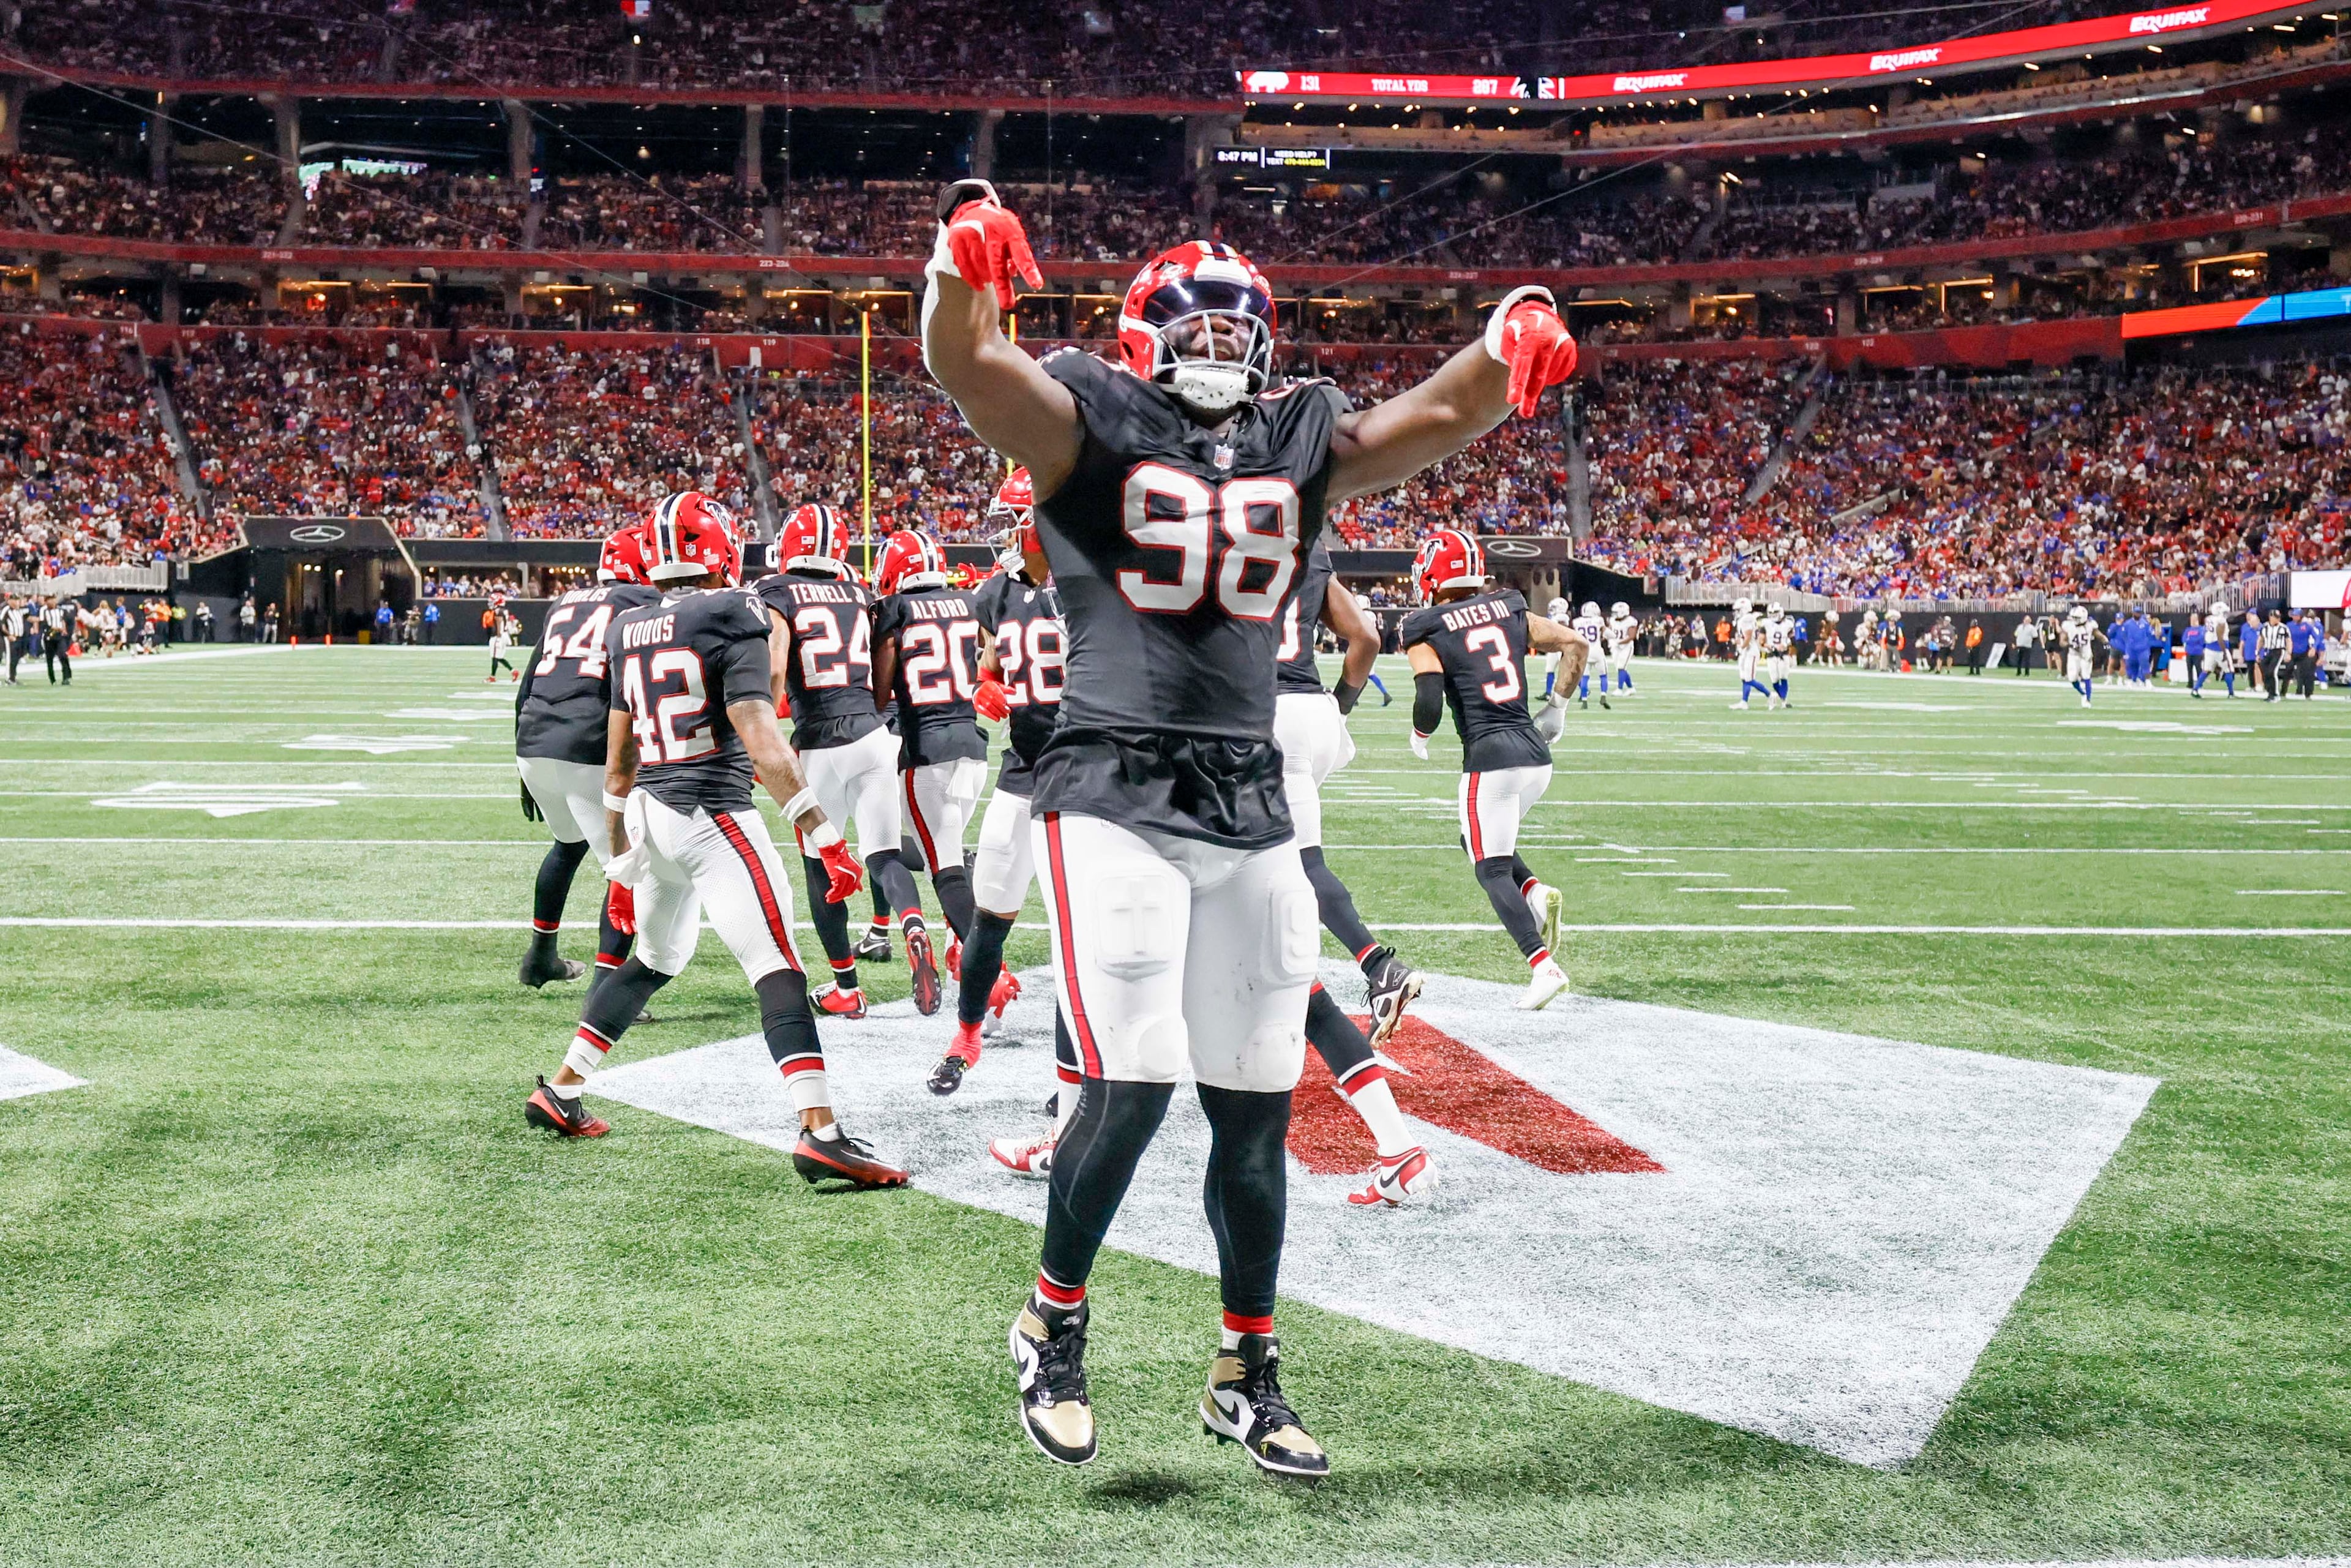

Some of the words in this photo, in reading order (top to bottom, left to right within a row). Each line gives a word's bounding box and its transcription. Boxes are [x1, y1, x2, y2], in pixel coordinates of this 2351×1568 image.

[2129, 7, 2208, 32] EQUIFAX
[1869, 48, 1940, 71] EQUIFAX
[1300, 75, 1320, 91] 131
[1371, 78, 1406, 92] TOTAL
[1406, 80, 1428, 92] YDS
[1613, 73, 1685, 92] EQUIFAX
[1240, 151, 1259, 162] PM
[1116, 461, 1302, 621] 98
[788, 583, 853, 605] TERRELL
[910, 598, 969, 620] ALFORD
[1441, 603, 1492, 632] BATES
[1489, 599, 1511, 620] III
[534, 604, 614, 680] 54
[622, 613, 676, 650] WOODS
[1578, 625, 1597, 642] 39
[1772, 631, 1782, 644] 9
[2072, 634, 2088, 645] 45
[793, 605, 874, 692] 24
[901, 618, 980, 707] 20
[994, 616, 1070, 707] 28
[1464, 623, 1523, 705] 3
[622, 647, 721, 765] 42
